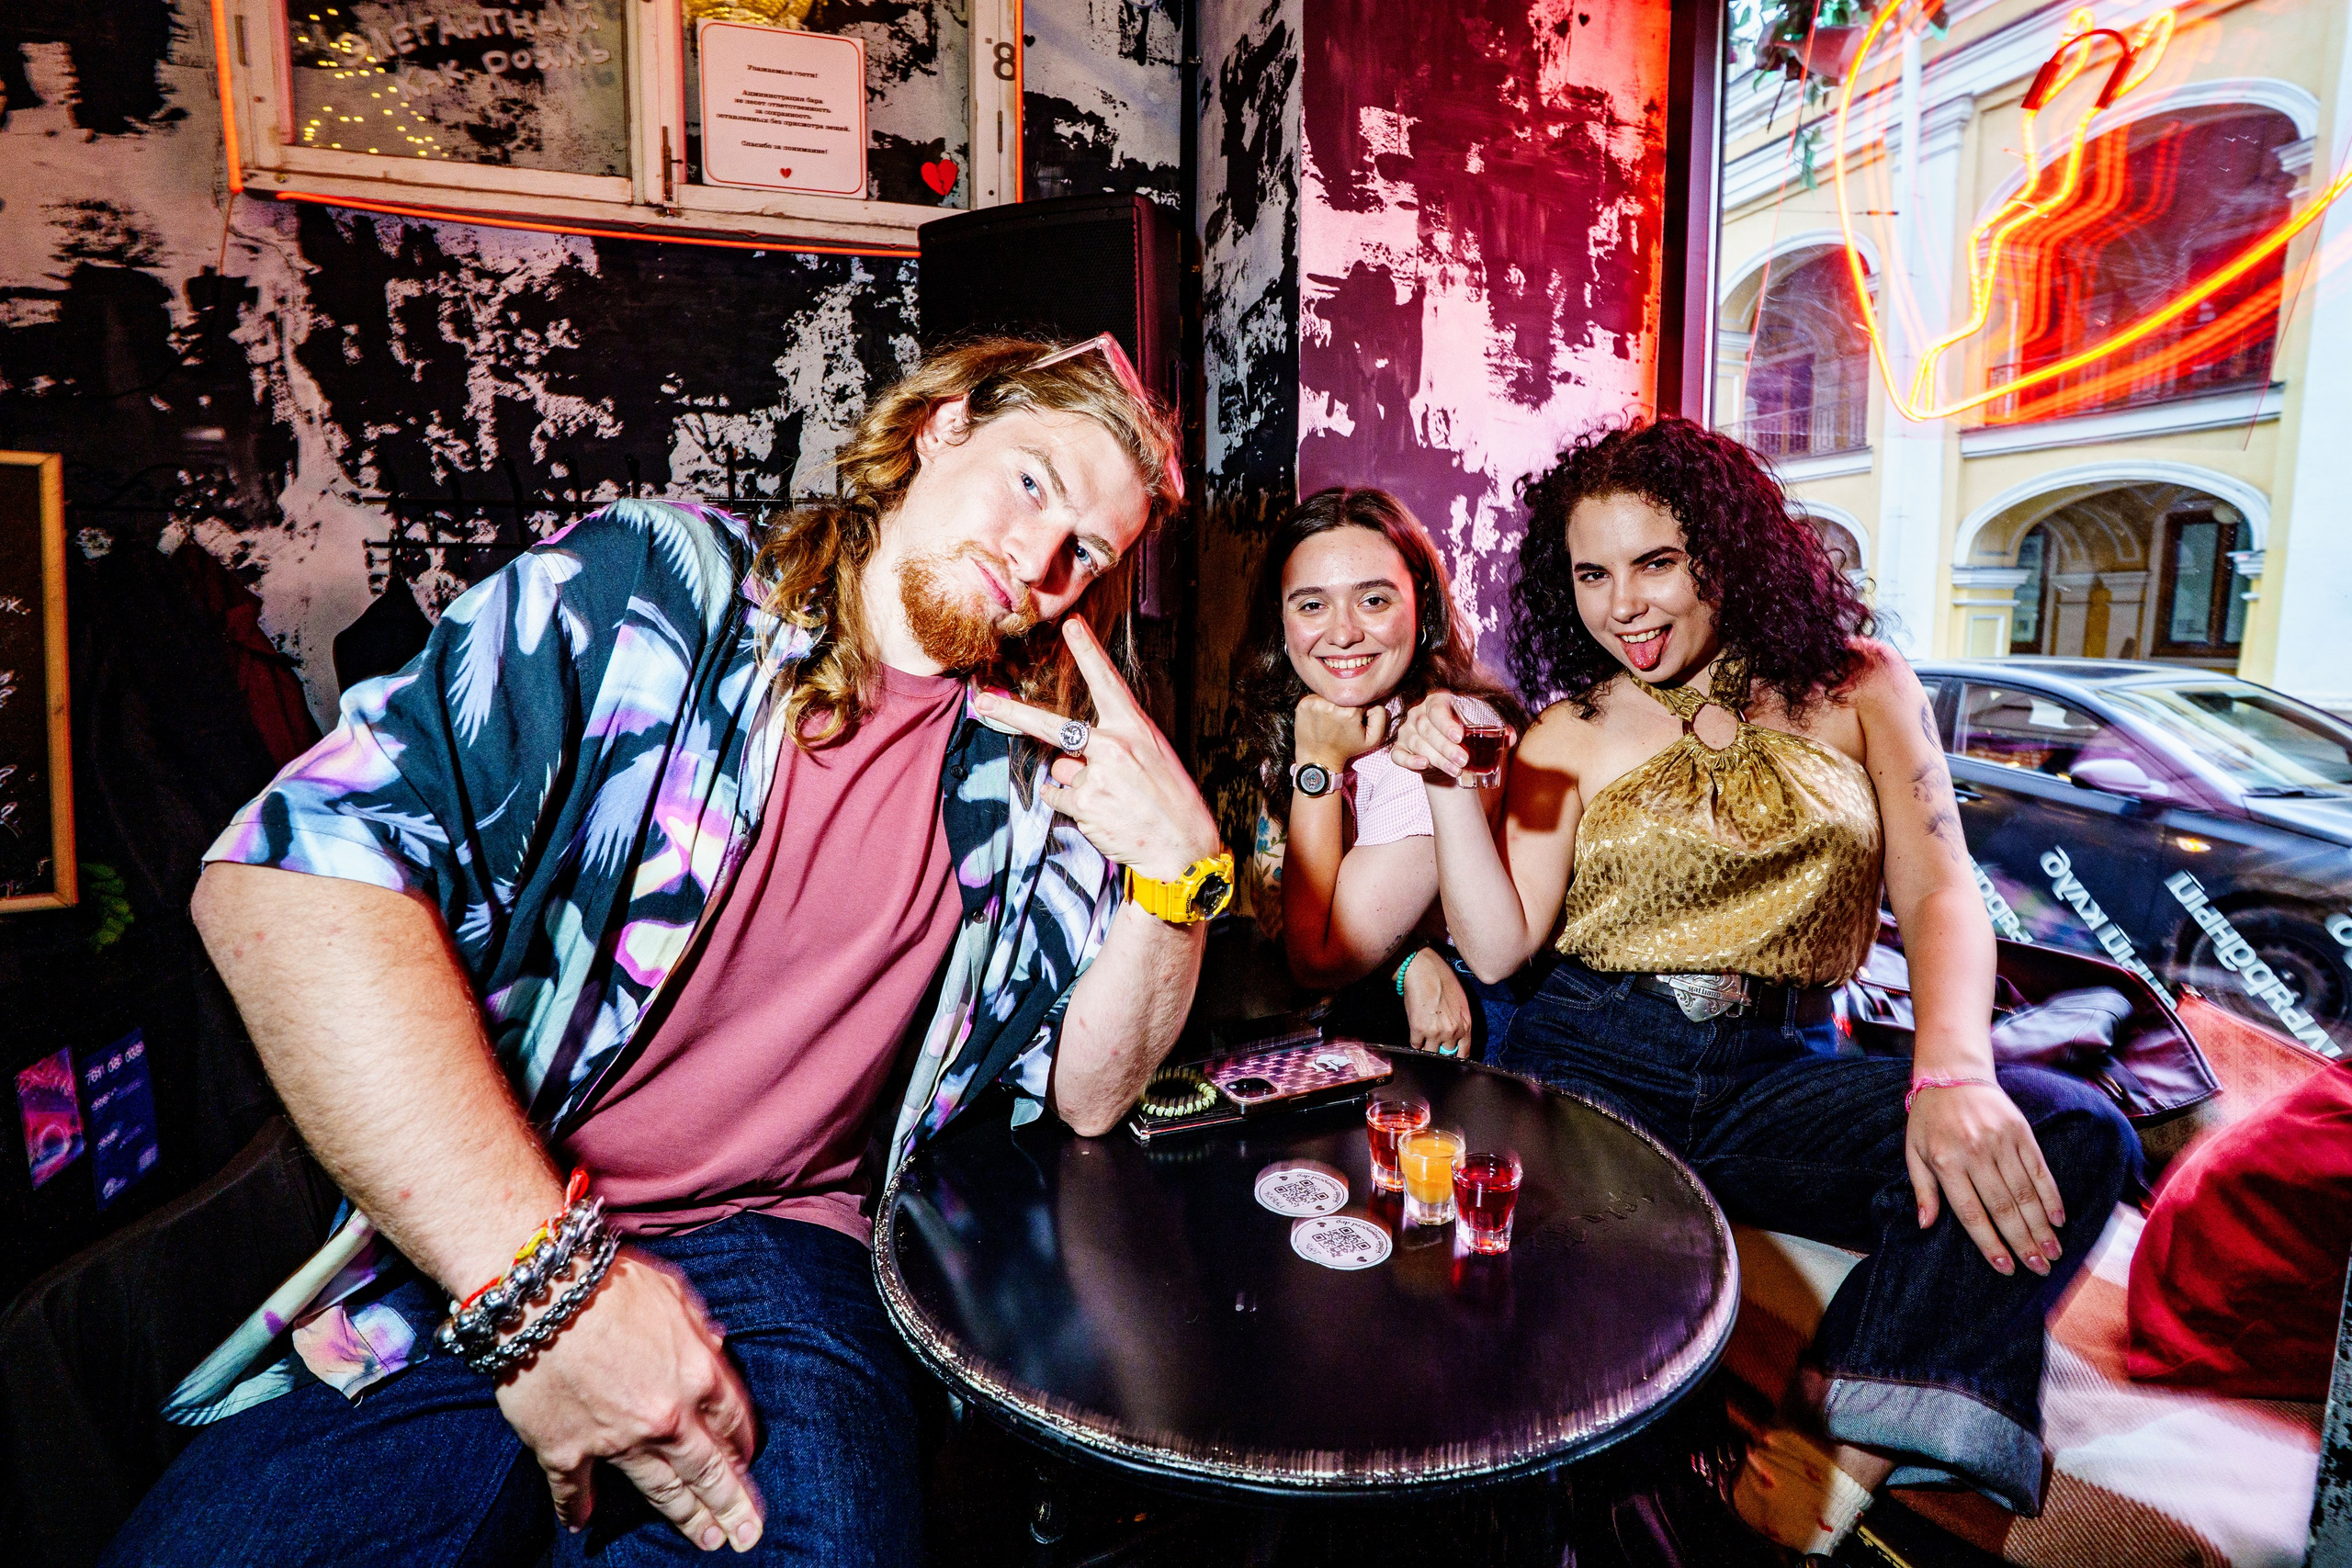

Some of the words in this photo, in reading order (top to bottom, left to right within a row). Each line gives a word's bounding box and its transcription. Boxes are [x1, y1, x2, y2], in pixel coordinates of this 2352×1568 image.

[993, 42, 1015, 81] 8
[747, 64, 793, 75] Уважаемые
[742, 90, 805, 102] Администрация
[806, 96, 823, 105] бара
[767, 102, 831, 113] ответственность
[764, 110, 812, 119] сохранность
[716, 113, 769, 124] оставленных
[784, 119, 824, 130] присмотра
[741, 141, 772, 149] Спасибо
[784, 145, 828, 154] понимание!
